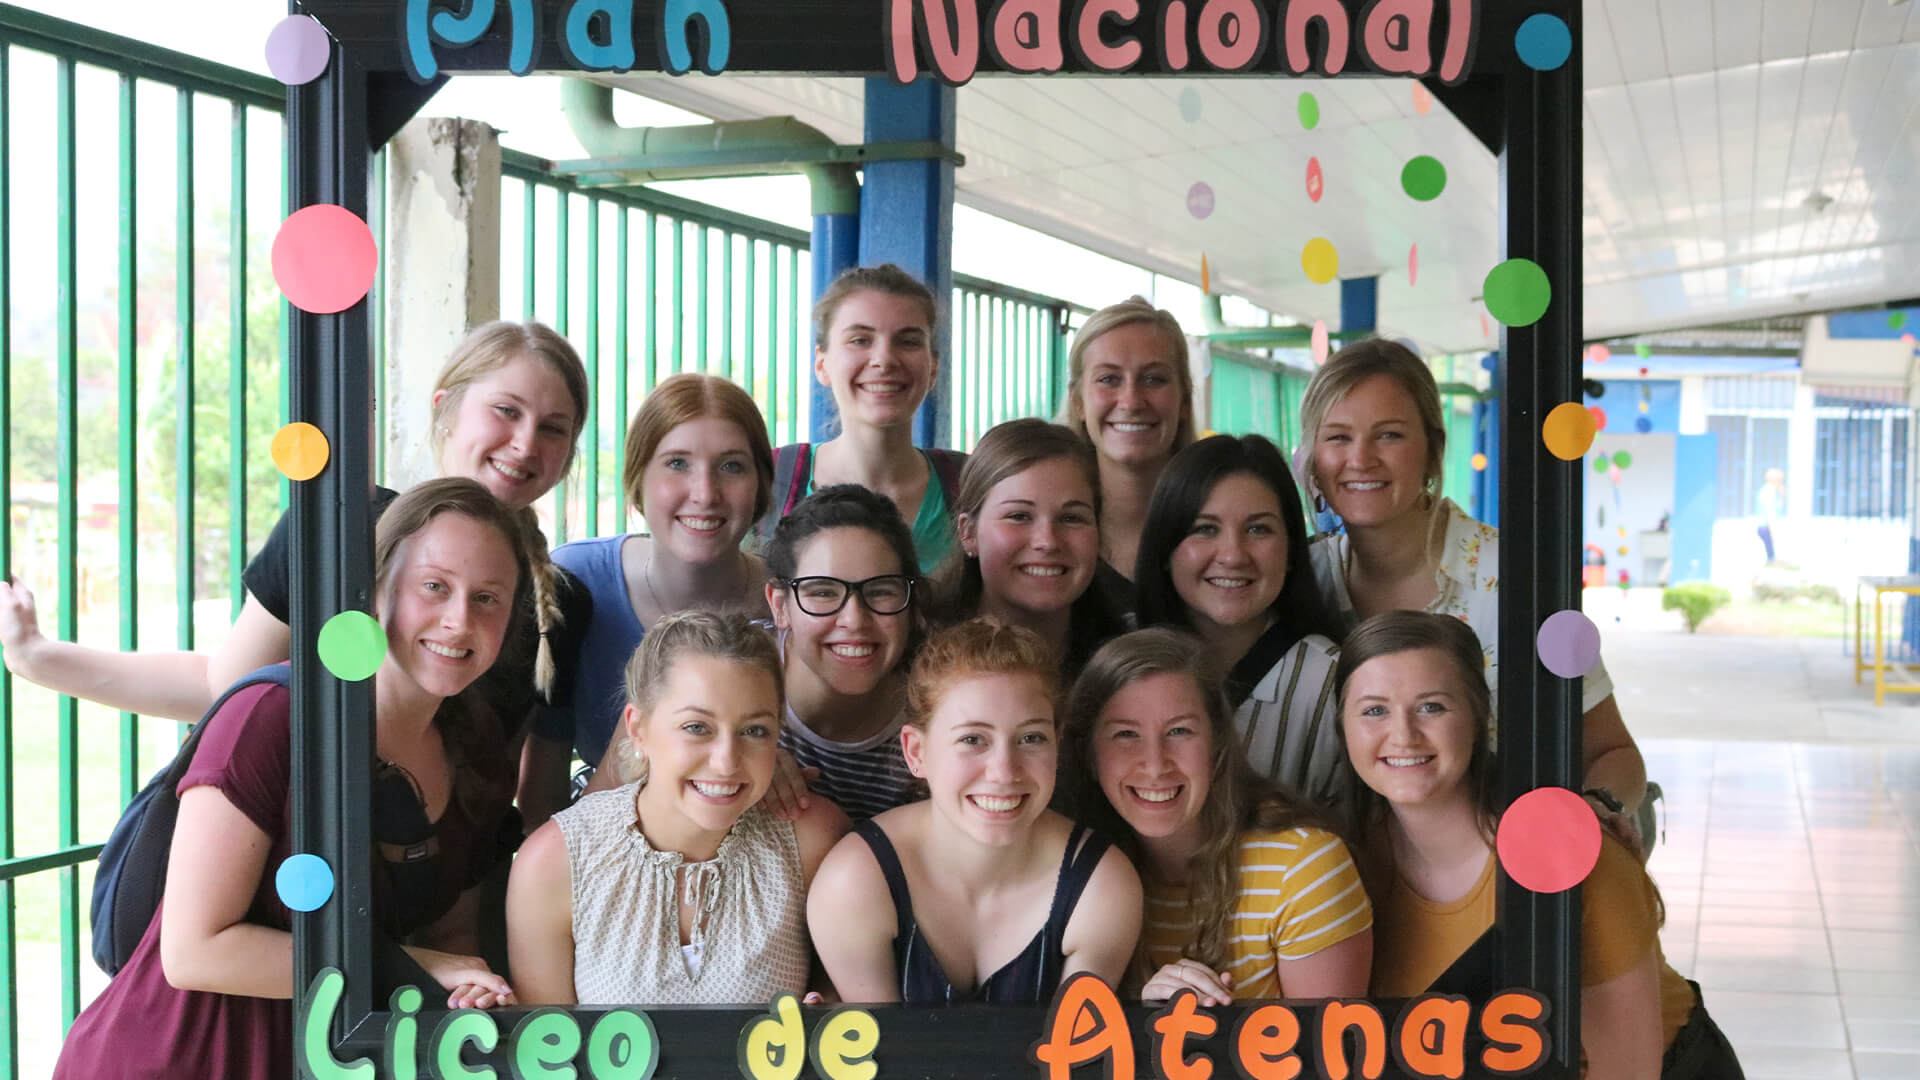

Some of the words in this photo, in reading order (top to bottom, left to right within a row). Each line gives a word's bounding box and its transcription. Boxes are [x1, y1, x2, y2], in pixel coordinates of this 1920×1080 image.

[405, 0, 729, 79] Plan
[891, 0, 1473, 83] Nacional
[302, 970, 654, 1080] Liceo
[743, 994, 881, 1080] de
[1034, 973, 1546, 1080] Atenas
